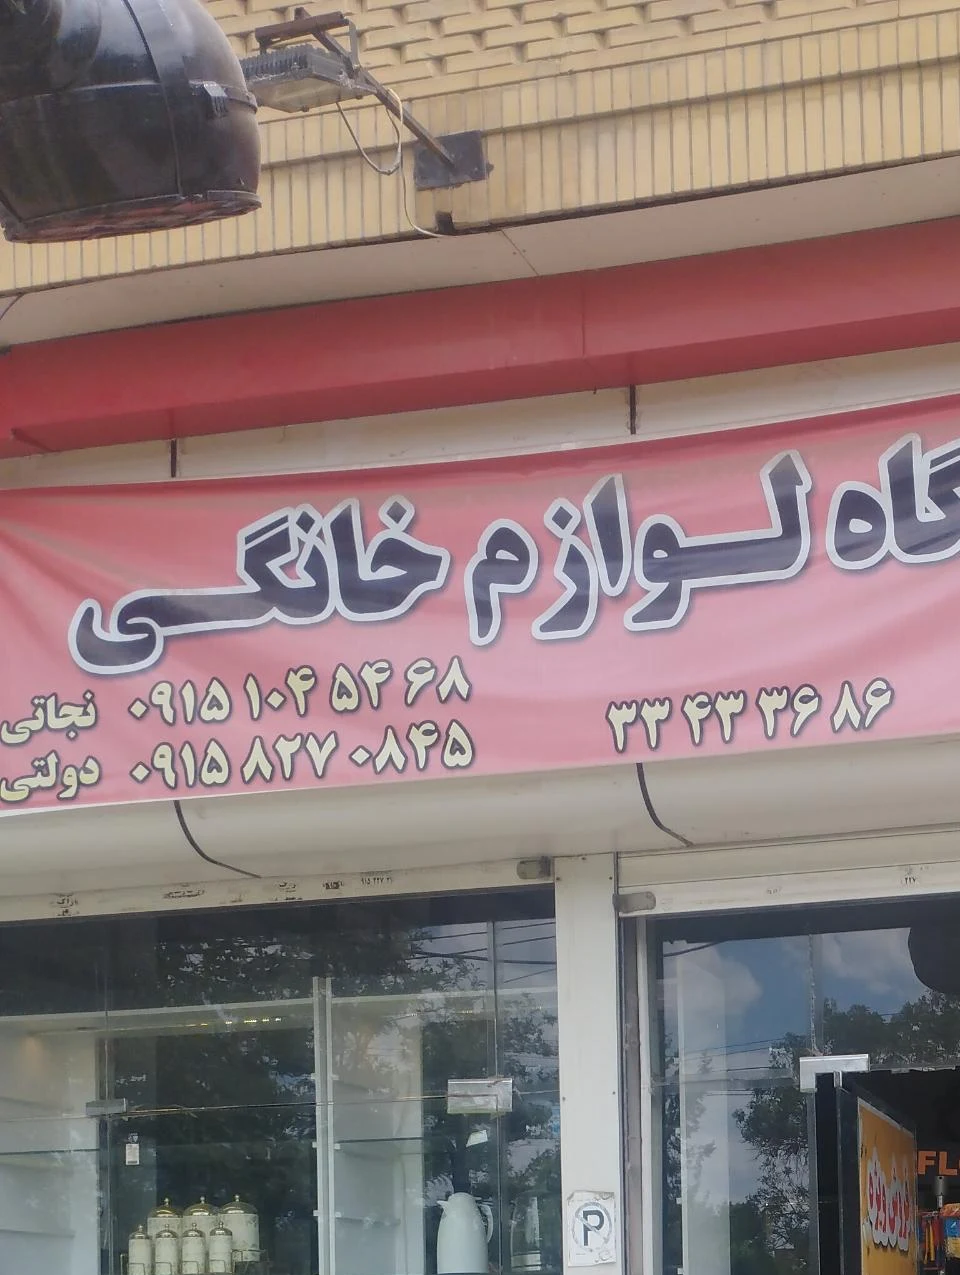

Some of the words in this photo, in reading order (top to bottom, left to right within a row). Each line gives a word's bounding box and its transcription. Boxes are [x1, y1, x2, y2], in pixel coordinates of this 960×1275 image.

[464, 449, 813, 646] لوازم
[68, 496, 450, 674] خانگی
[128, 678, 233, 725] ۰۹۱۵
[243, 665, 318, 721] ۱۰۴
[331, 659, 394, 712] ۵۴
[404, 655, 471, 703] ۶۸
[0, 689, 97, 745] نجاتی
[606, 697, 673, 754] ۳۳
[682, 689, 747, 748] ۴۳
[757, 684, 821, 740] ۳۶
[830, 676, 895, 732] ۸۶
[129, 738, 231, 789] ۰۹۱۵
[241, 731, 339, 785] ۸۲۷
[349, 718, 476, 774] ۰۸۴۵
[0, 751, 102, 801] دولتی
